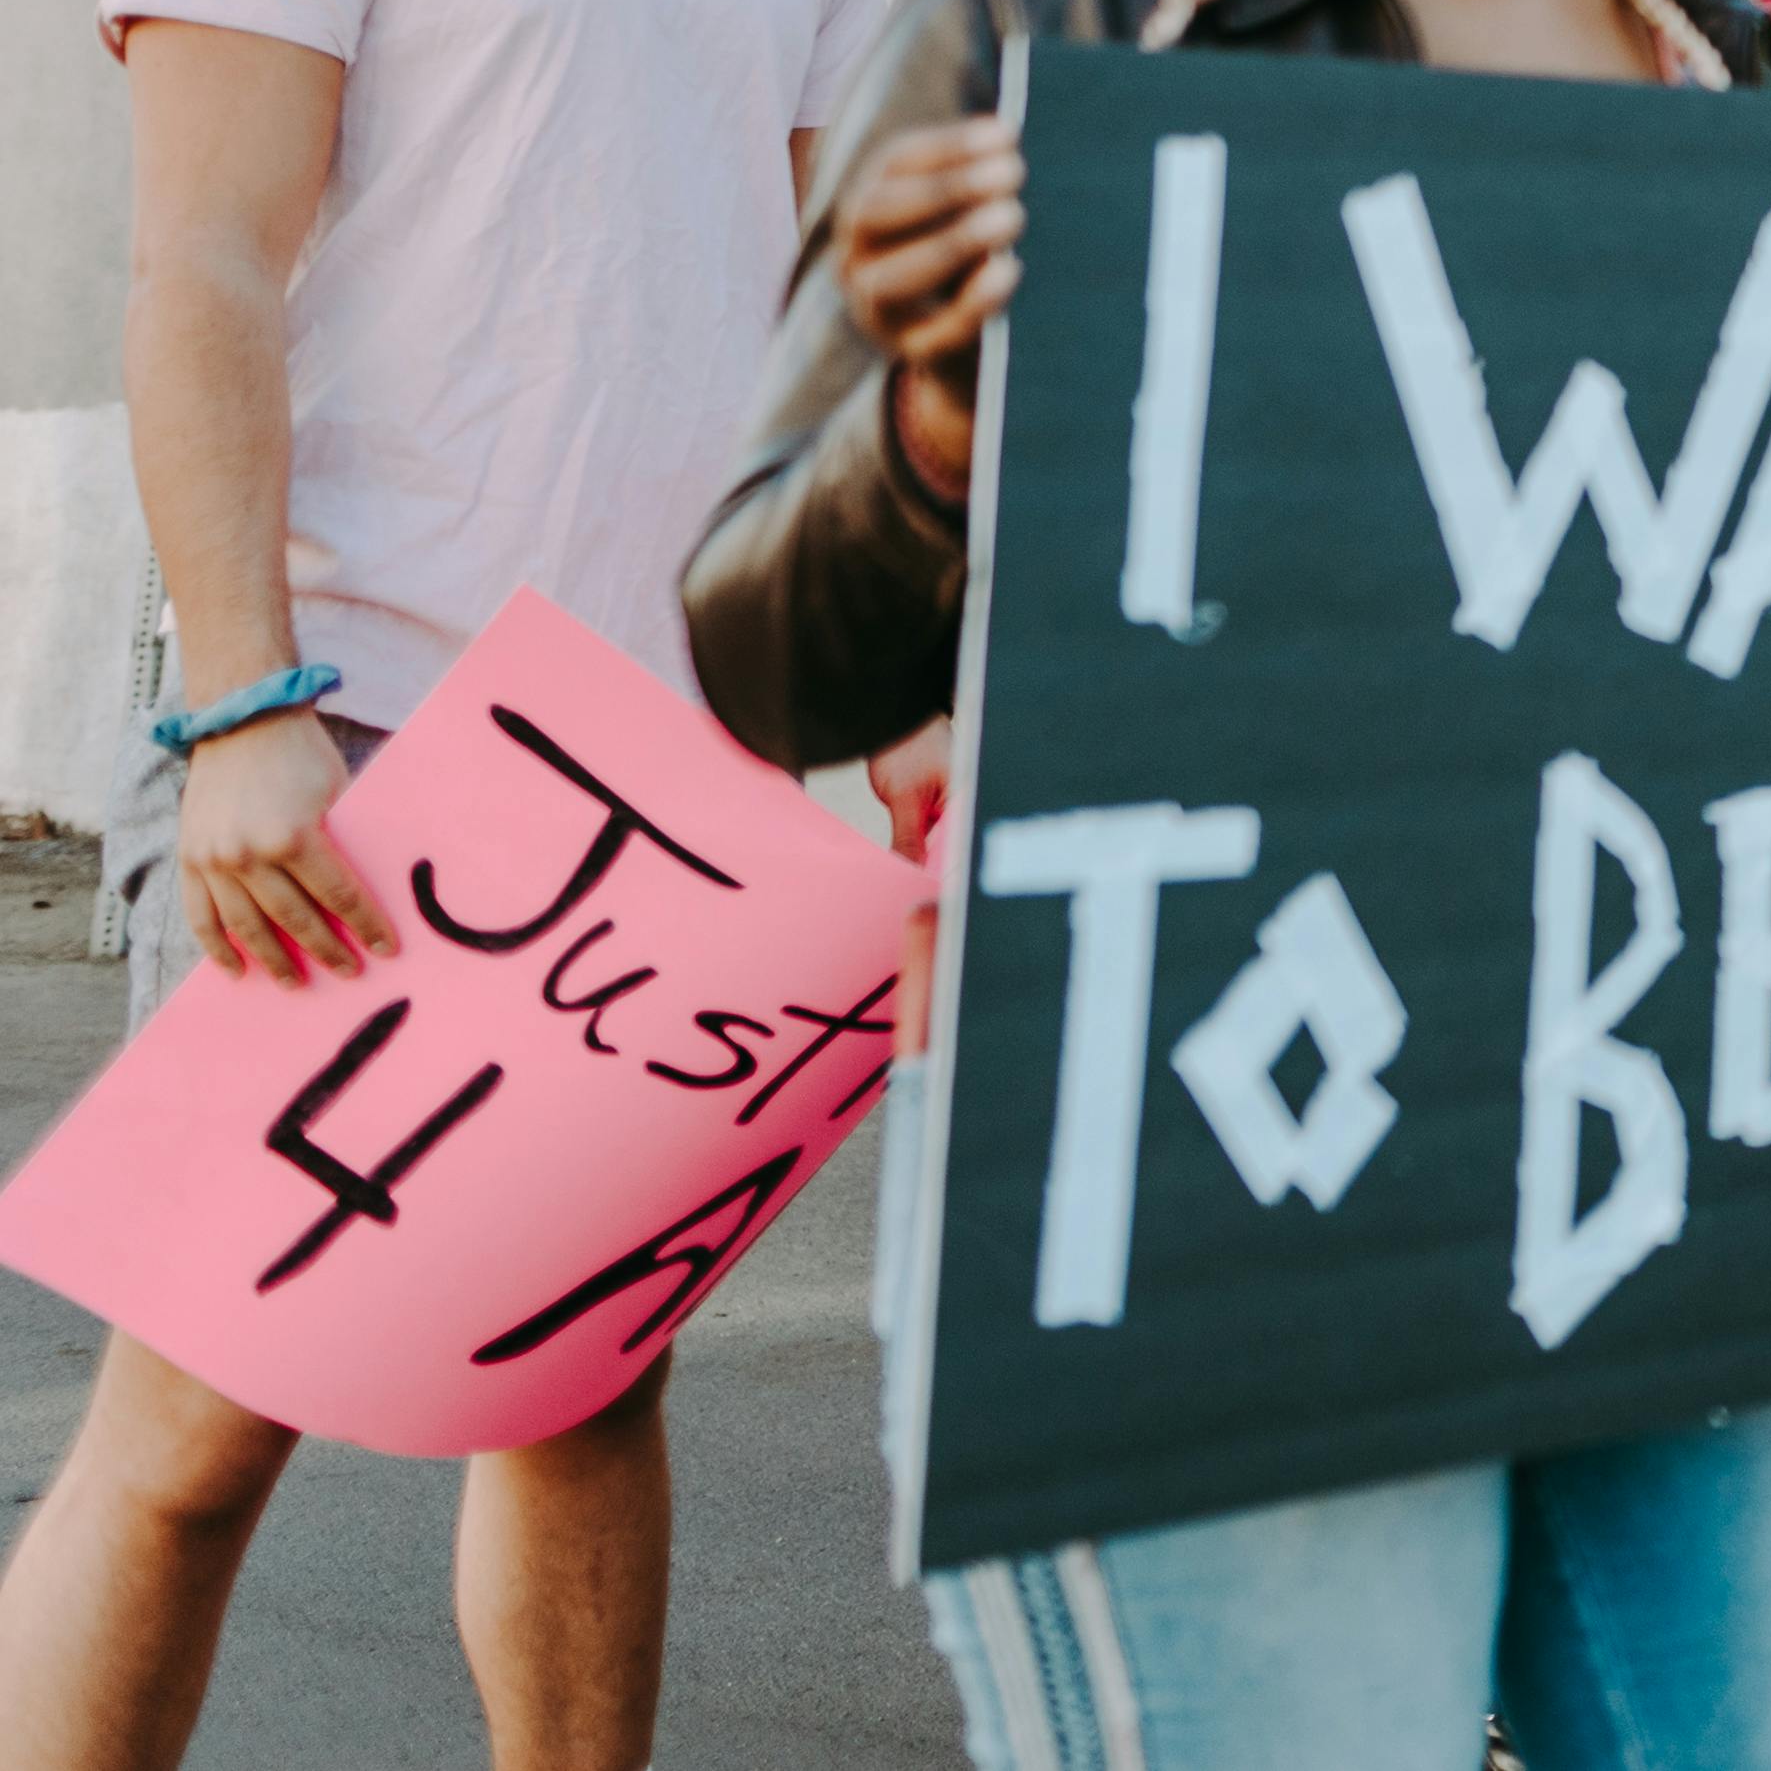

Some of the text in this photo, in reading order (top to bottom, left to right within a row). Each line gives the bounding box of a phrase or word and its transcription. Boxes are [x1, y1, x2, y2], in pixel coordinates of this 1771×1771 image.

[1119, 132, 1228, 633] I
[255, 997, 805, 1365] 4 A
